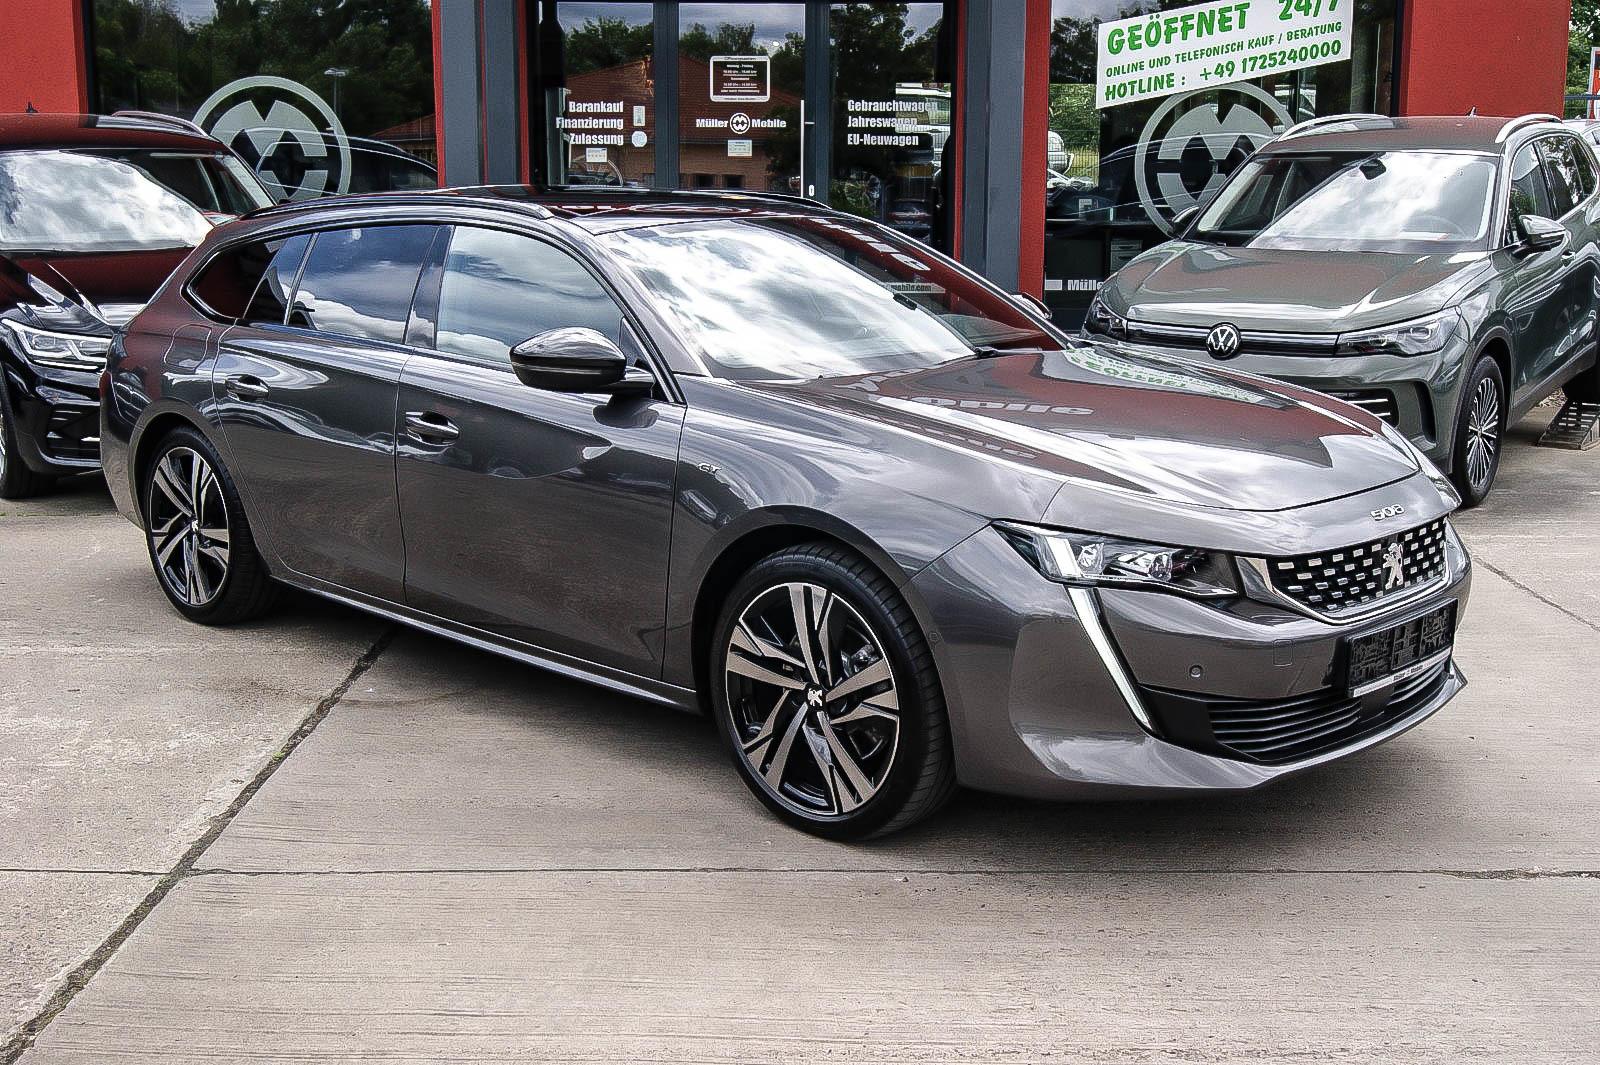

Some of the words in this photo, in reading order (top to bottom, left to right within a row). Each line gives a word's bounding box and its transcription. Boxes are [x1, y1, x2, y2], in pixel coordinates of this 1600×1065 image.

[1107, 3, 1250, 55] GEÖFFNET
[1278, 0, 1339, 20] 24/7
[1106, 60, 1145, 78] ONLINE
[1149, 56, 1171, 69] UND
[1175, 40, 1244, 64] TELEFONISCH
[1248, 34, 1275, 50] KAUF
[1286, 21, 1342, 42] BERATUNG
[1105, 72, 1175, 101] HOTLINE
[1199, 60, 1236, 82] +49
[1242, 39, 1342, 75] 1725240000
[569, 101, 624, 113] Barankauf
[847, 100, 938, 114] Gebrauchtwagen
[556, 117, 624, 130] Finanzierung
[696, 118, 729, 128] Müller
[752, 118, 787, 128] Mobile
[847, 116, 918, 129] Jahreswagen
[569, 133, 624, 146] Zulassung
[847, 134, 919, 147] EU-Neuwagen
[1067, 280, 1105, 291] Mülle
[1370, 503, 1405, 521] 508
